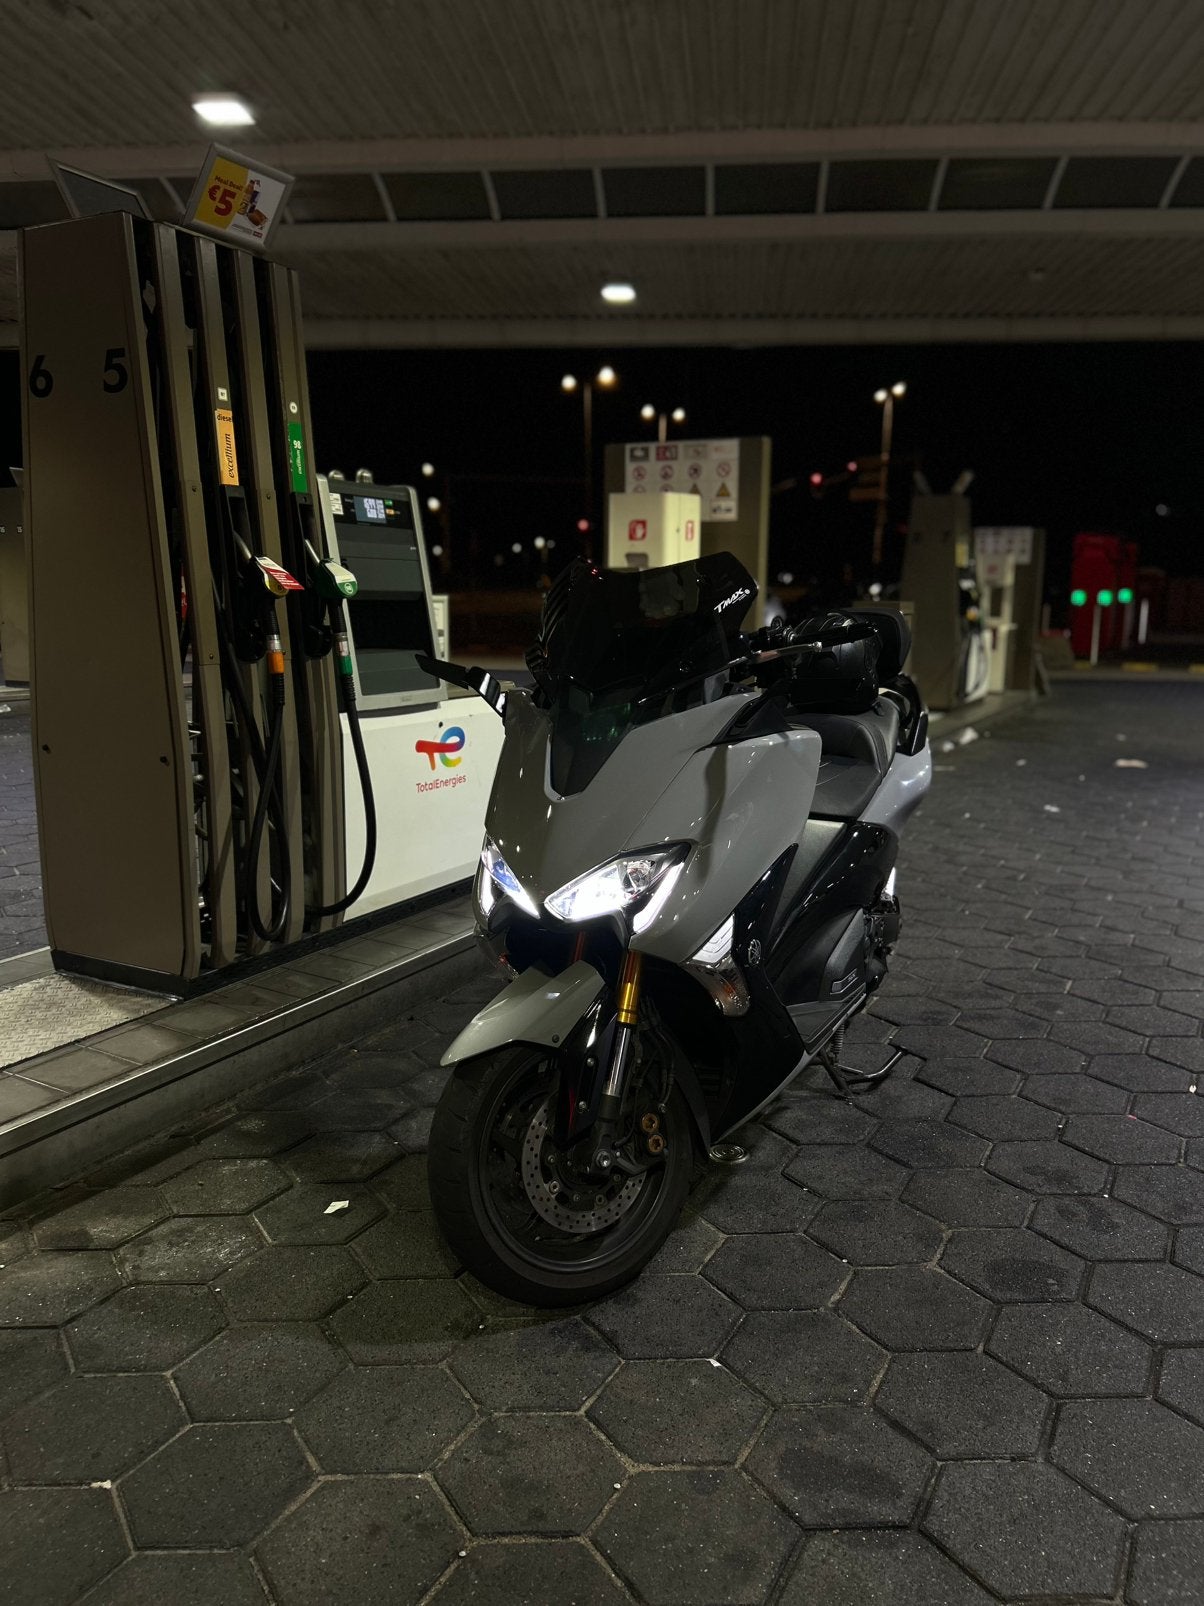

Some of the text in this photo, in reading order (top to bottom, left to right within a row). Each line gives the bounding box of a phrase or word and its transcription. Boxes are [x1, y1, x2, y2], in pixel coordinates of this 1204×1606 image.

[29, 354, 53, 398] 6
[103, 347, 128, 393] 5
[225, 433, 235, 478] excellium
[713, 587, 744, 613] TMAX
[415, 774, 467, 793] TotalEnergies
